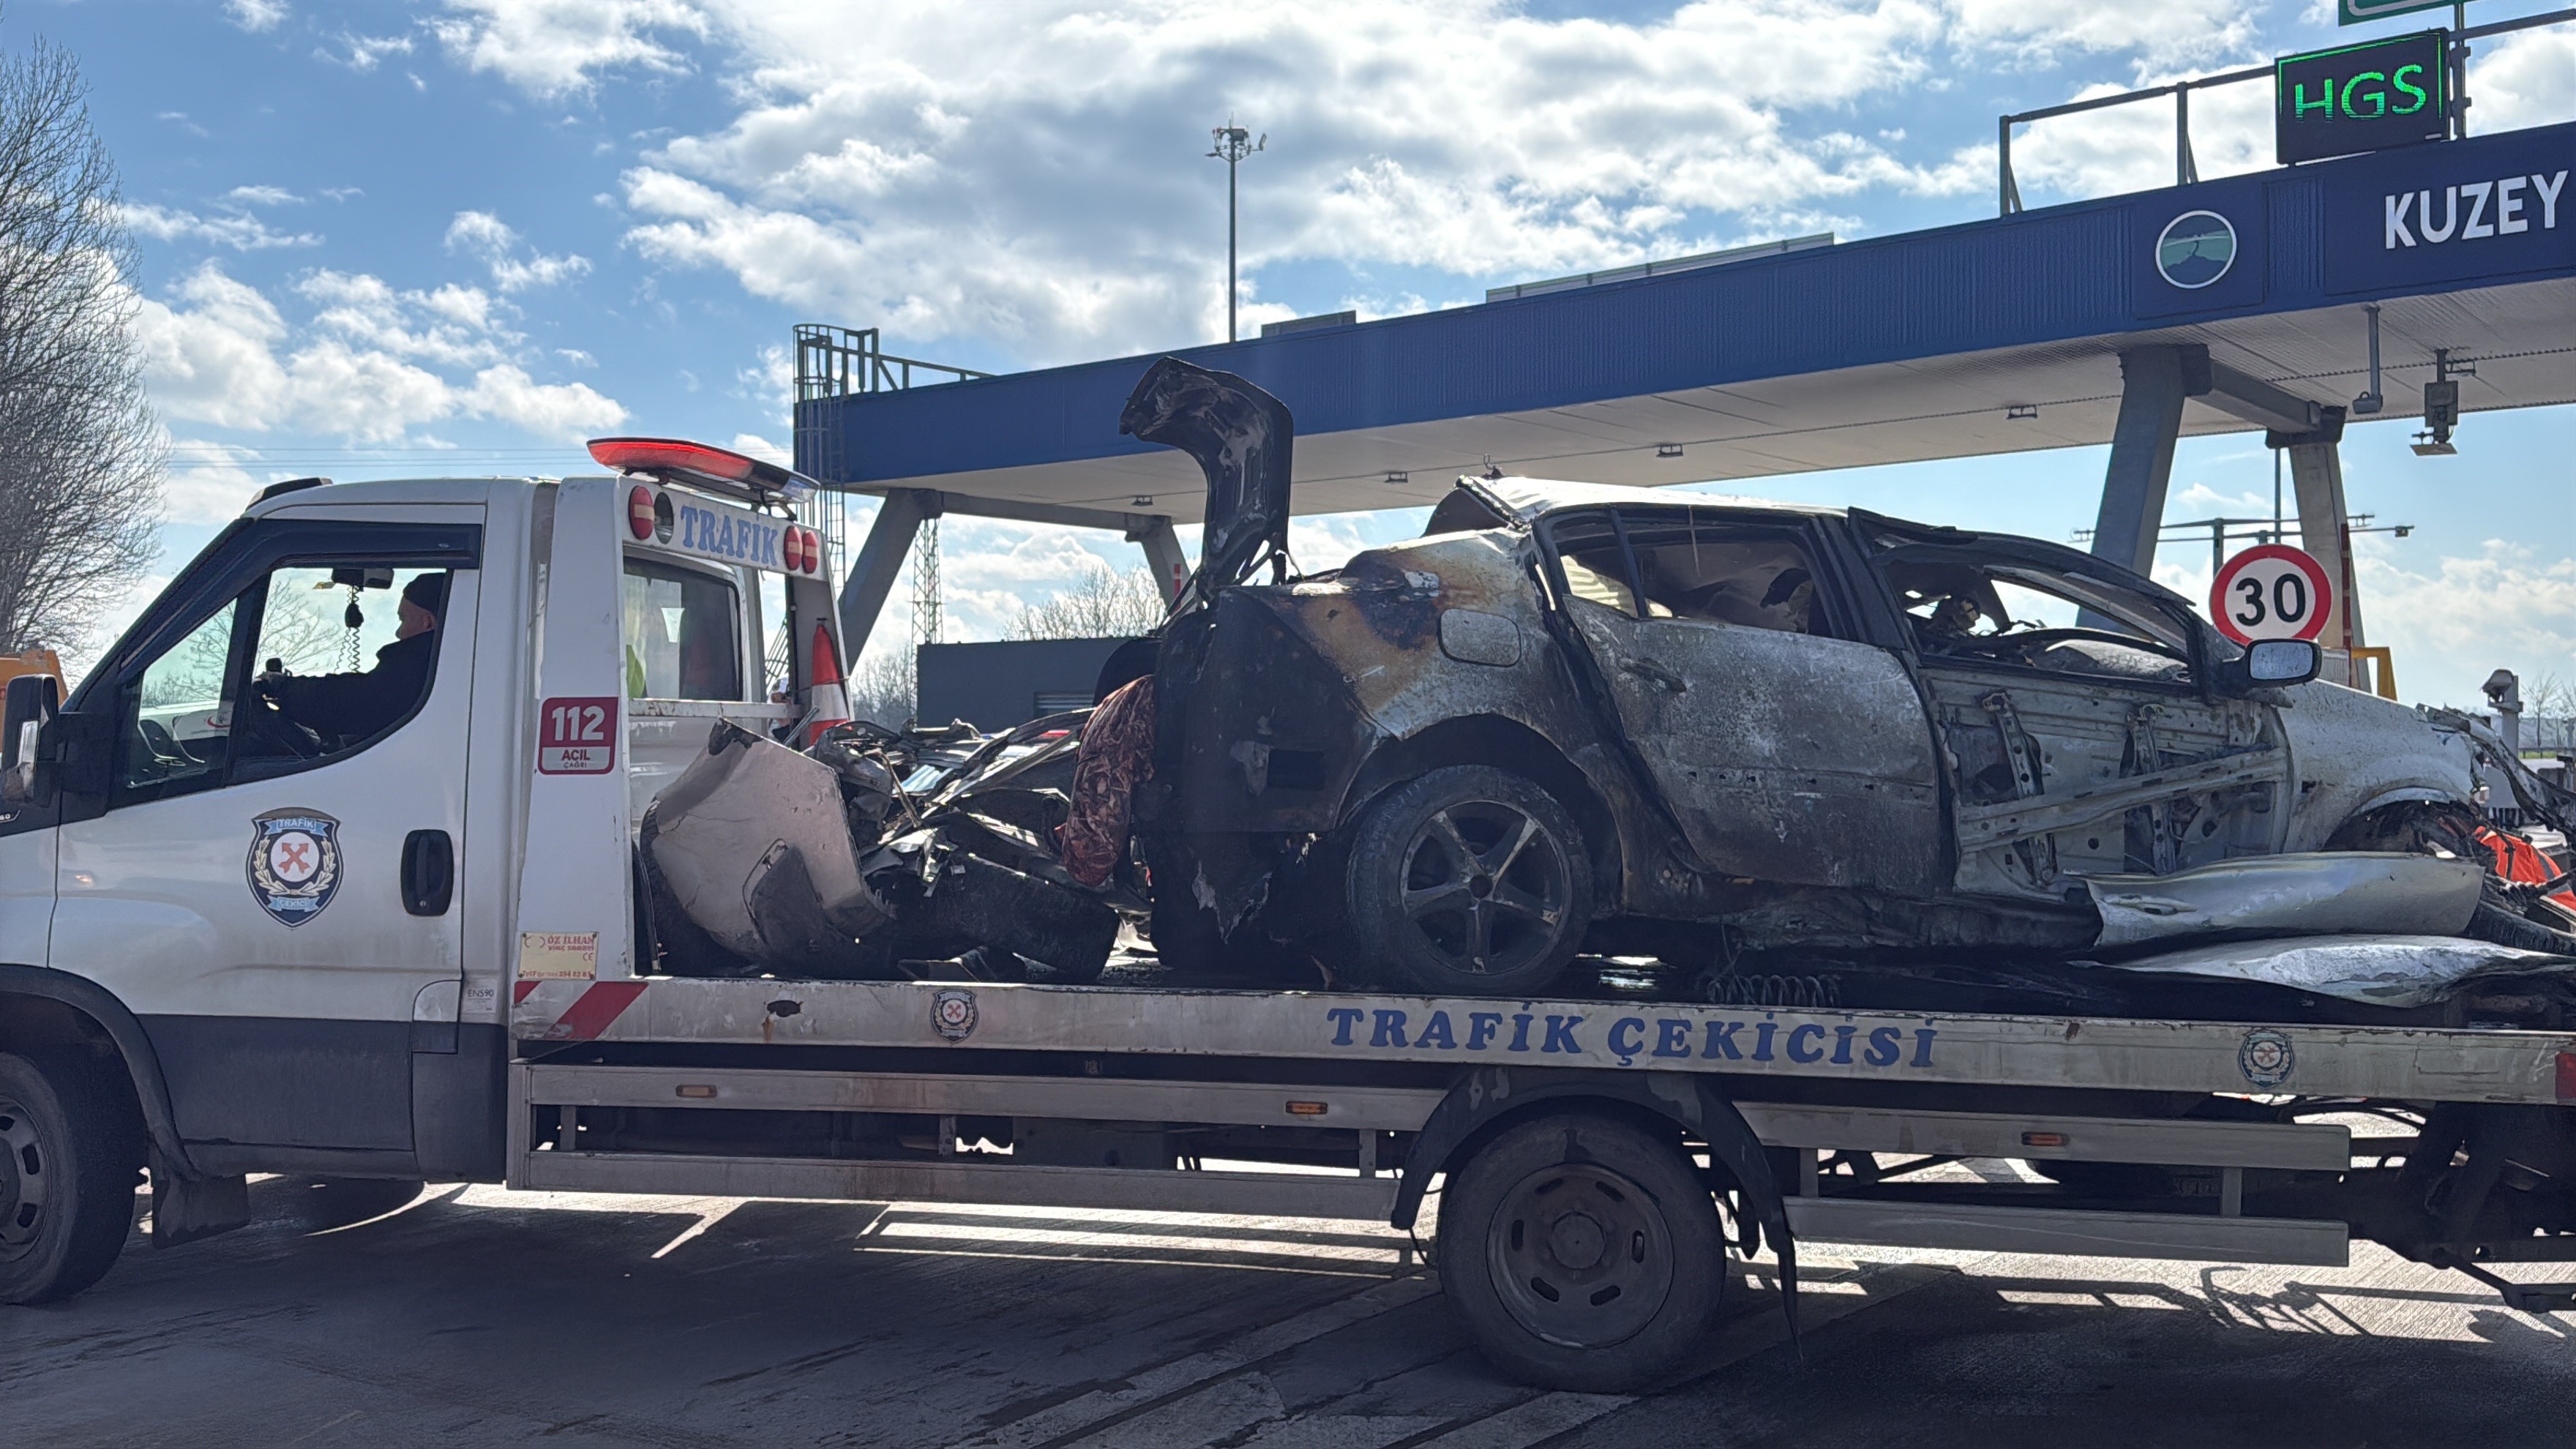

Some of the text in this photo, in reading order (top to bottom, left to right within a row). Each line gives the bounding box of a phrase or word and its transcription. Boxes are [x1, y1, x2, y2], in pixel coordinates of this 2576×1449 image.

[2294, 64, 2427, 123] HGS
[2385, 170, 2569, 250] KUZEY
[680, 504, 779, 567] TRAFİK
[2235, 572, 2307, 626] 30
[551, 705, 606, 742] 112
[278, 816, 315, 828] TRAFİK
[1326, 1001, 1939, 1067] TRAFİK ÇEKİCİSİ
